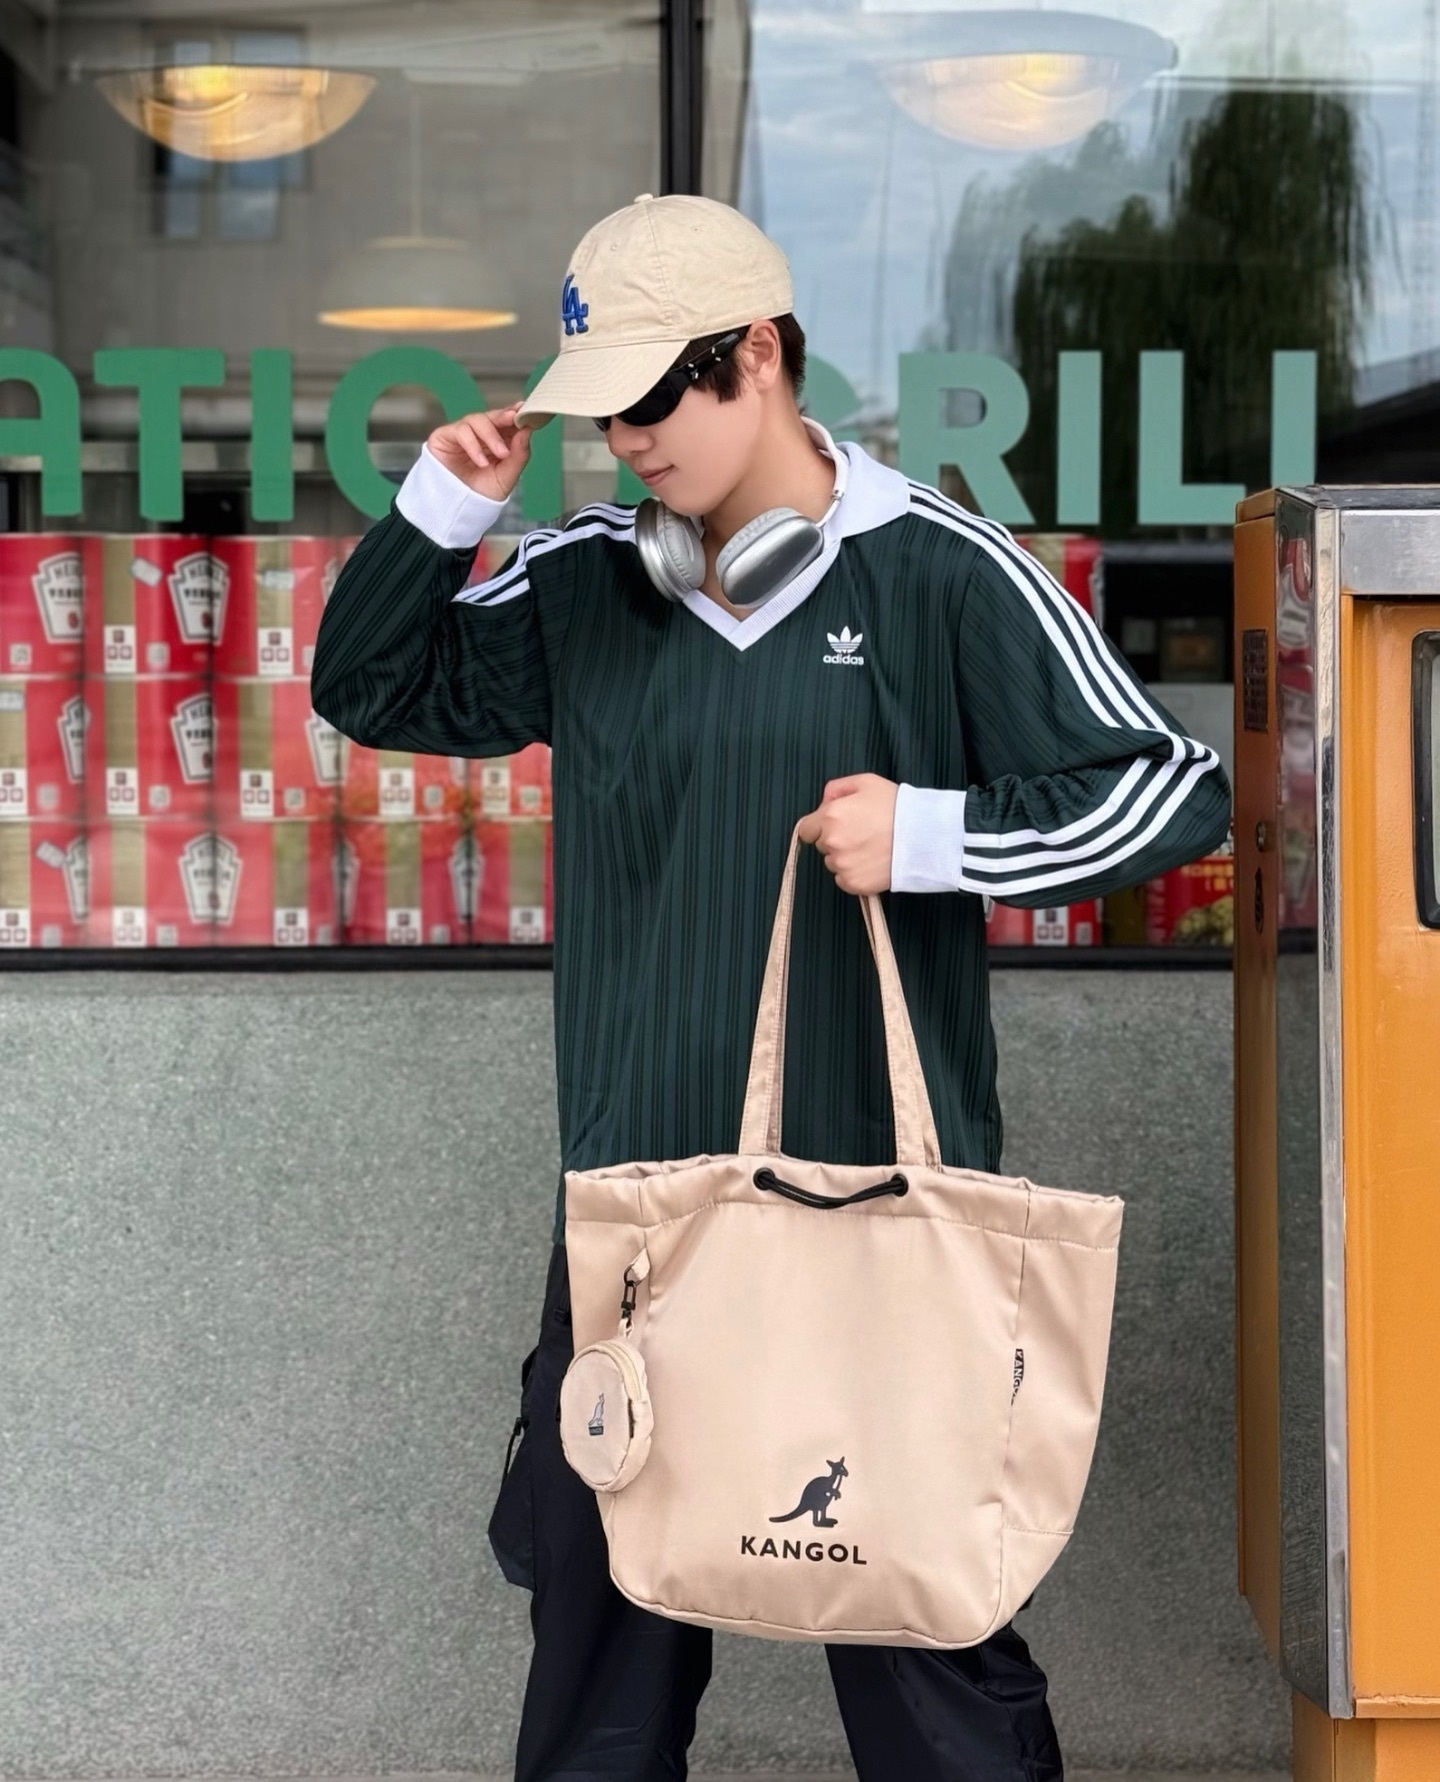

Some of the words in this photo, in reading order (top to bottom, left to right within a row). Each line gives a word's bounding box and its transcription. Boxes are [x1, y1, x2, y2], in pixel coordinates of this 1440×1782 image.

[800, 350, 1317, 525] RIL
[822, 653, 865, 666] adidas
[740, 1535, 868, 1566] KANGOL
